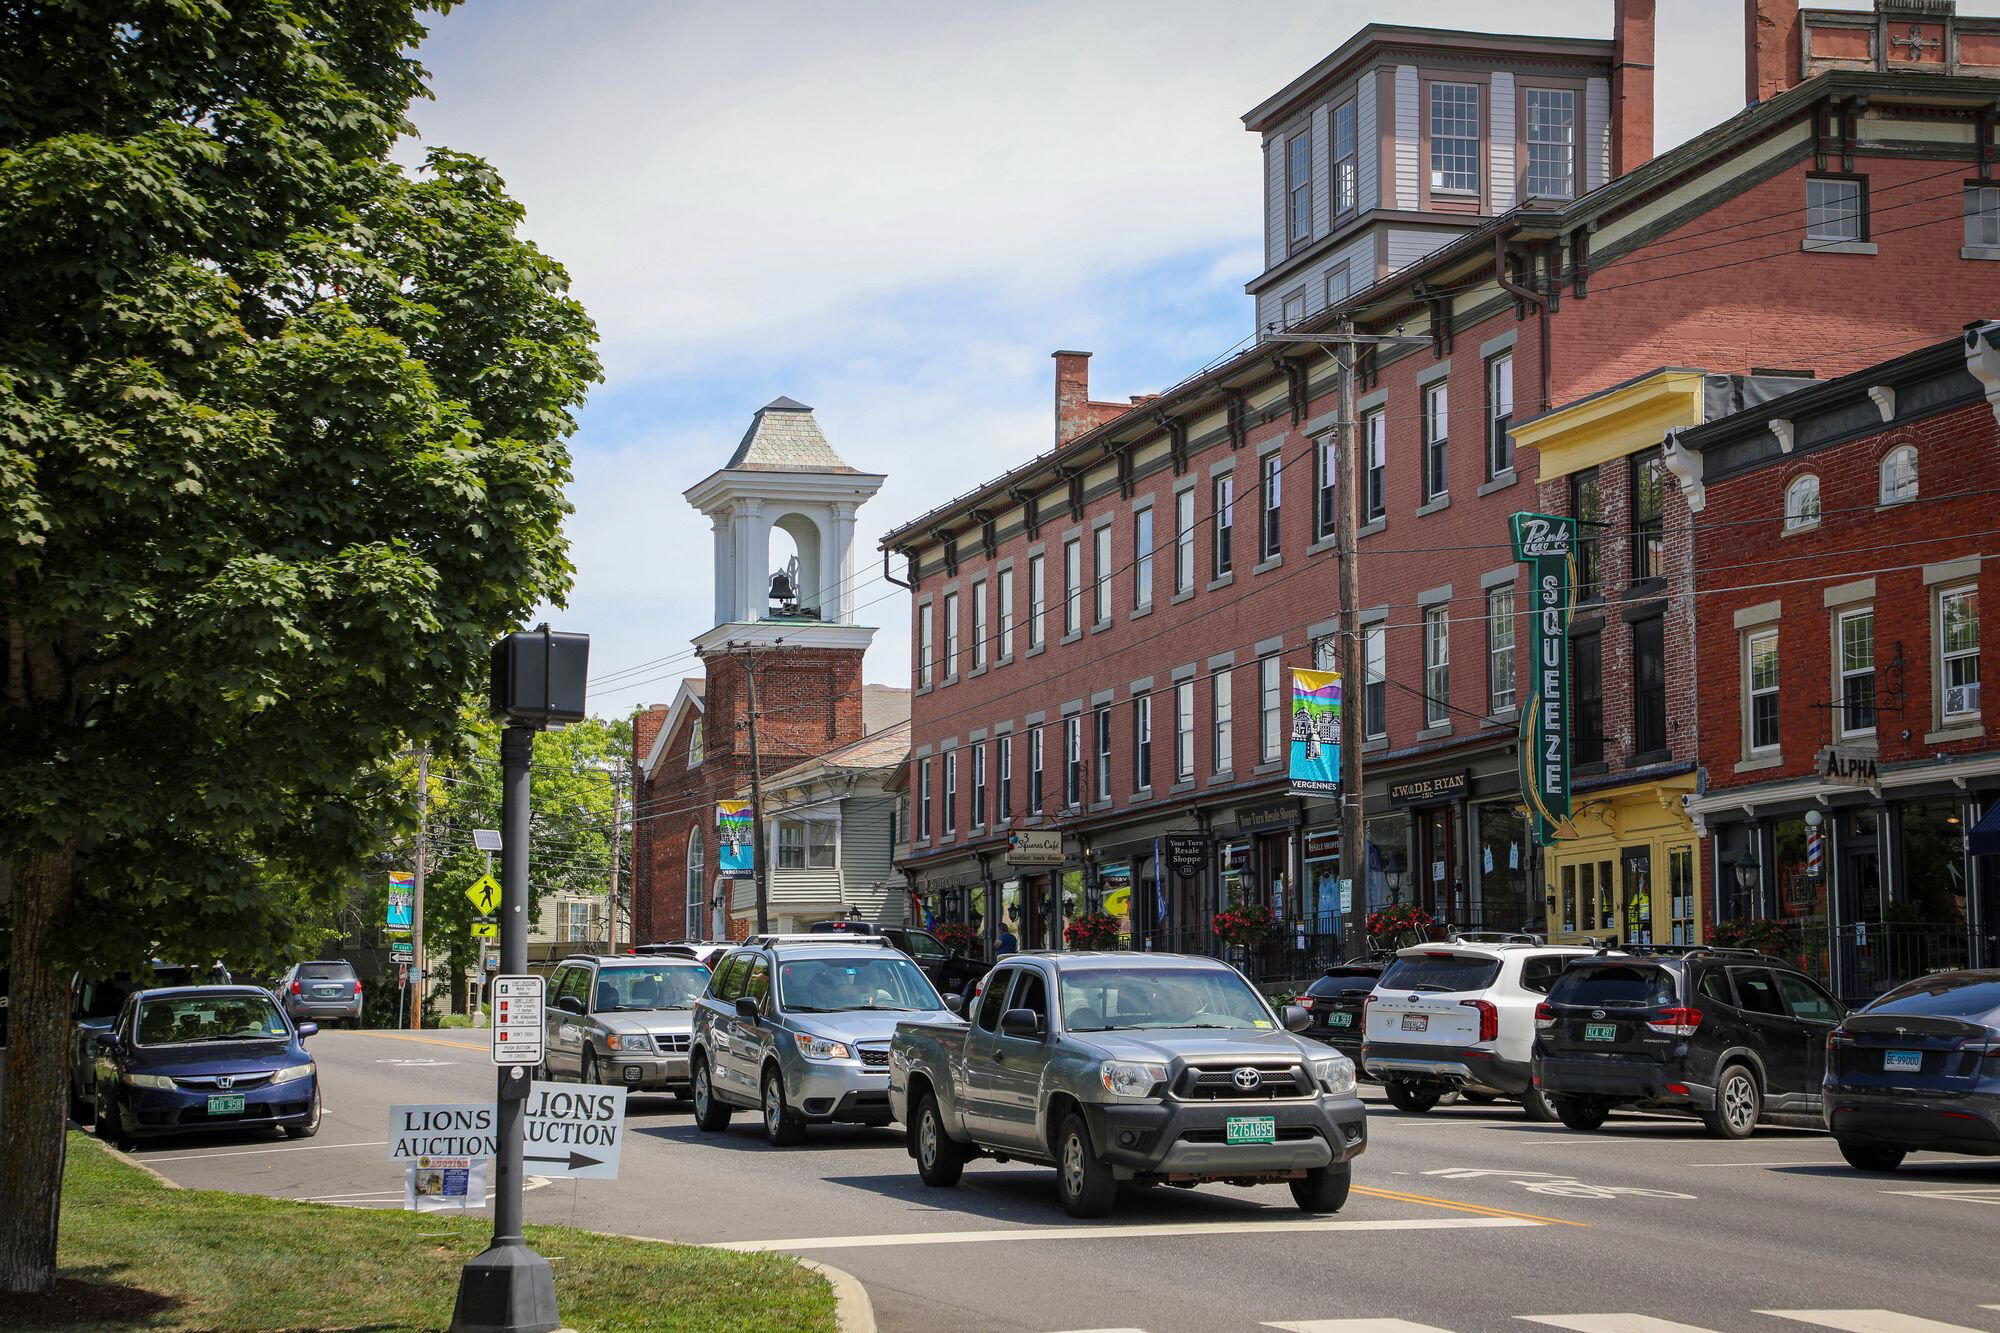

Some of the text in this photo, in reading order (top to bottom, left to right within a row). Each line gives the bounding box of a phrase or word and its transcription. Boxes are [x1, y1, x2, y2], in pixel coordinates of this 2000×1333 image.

[1521, 520, 1569, 555] Park
[1543, 575, 1563, 794] SQUEEZE
[1827, 751, 1877, 777] ALPHA
[1292, 780, 1336, 790] VERGENNES
[1434, 775, 1464, 789] RYAN
[1240, 814, 1252, 826] Your
[1252, 813, 1265, 823] Turn
[1280, 808, 1298, 822] Shoppe
[1018, 840, 1043, 852] Squares
[1023, 833, 1029, 843] 3
[1173, 856, 1201, 864] Shoppe
[405, 1111, 491, 1130] LIONS
[394, 1135, 497, 1157] AUCTION
